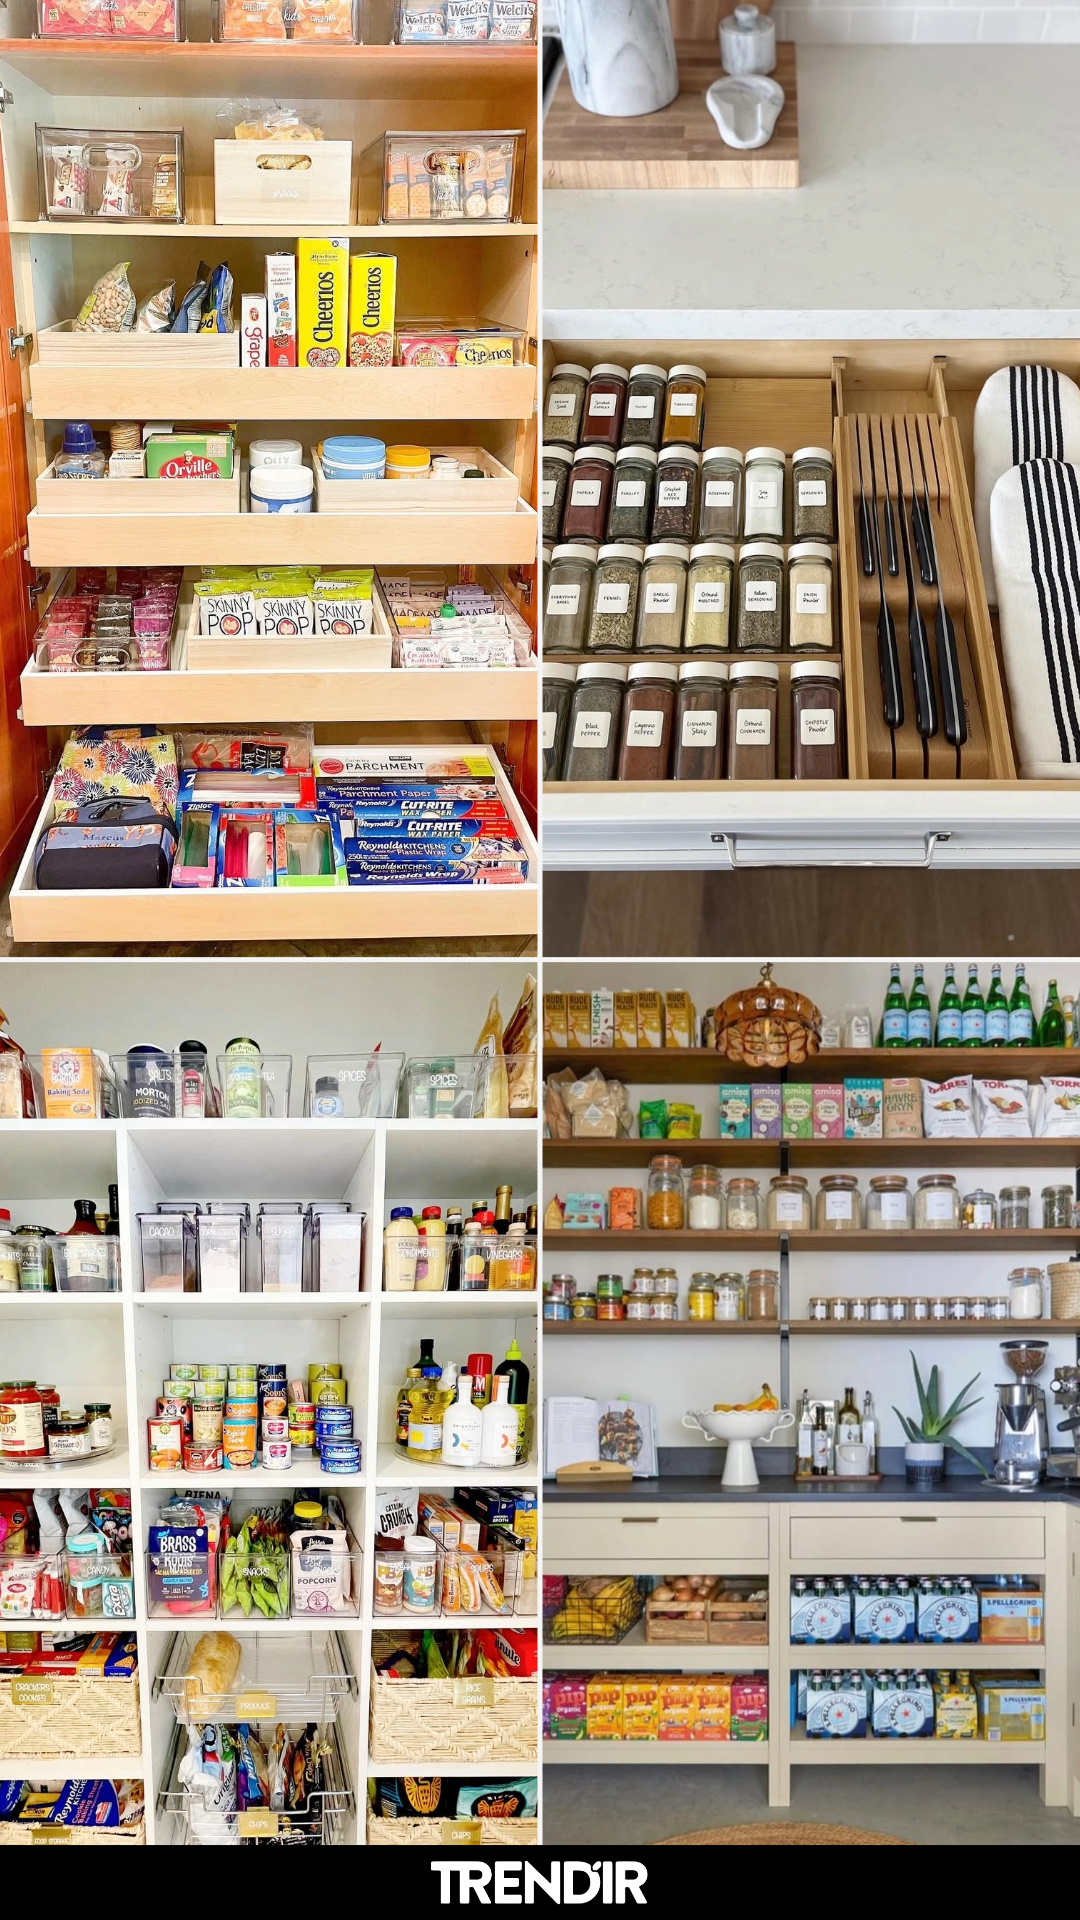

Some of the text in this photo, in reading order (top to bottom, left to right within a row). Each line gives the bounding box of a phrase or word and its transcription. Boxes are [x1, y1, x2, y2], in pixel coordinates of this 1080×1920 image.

[449, 1, 489, 17] Welch's
[496, 4, 535, 16] Welch's
[405, 15, 442, 25] Welch's
[362, 267, 382, 328] Cheerios
[312, 271, 334, 343] Cheerios
[263, 455, 292, 466] OLLY
[165, 460, 213, 479] Orville
[207, 593, 251, 613] SKINNY
[262, 600, 306, 617] SKINNY
[317, 603, 363, 619] SKINNY
[208, 611, 254, 636] POP
[264, 616, 310, 636] POP
[319, 619, 366, 635] POP
[633, 721, 655, 732] Cayenne
[743, 719, 763, 727] Ground
[808, 725, 828, 733] Powder
[345, 762, 425, 771] PARCHMENT
[339, 790, 431, 798] Parchment Paper
[187, 803, 213, 811] Ziploc
[400, 801, 454, 810] CUT-RITE
[360, 820, 396, 829] Reynolds
[407, 821, 463, 831] CUT-RITE
[82, 833, 125, 842] Marcus
[365, 871, 459, 881] Reynolds Wrap
[546, 995, 564, 1004] RUDE
[569, 995, 588, 1004] RUDE
[615, 995, 634, 1004] RUDE
[638, 992, 657, 1002] RUDE
[667, 992, 686, 1002] RUDE
[338, 1070, 367, 1082] SPICES
[430, 1074, 458, 1086] SPICES
[135, 1087, 170, 1101] MORTON
[721, 1087, 749, 1096] amisa
[753, 1086, 781, 1095] amisa
[784, 1086, 812, 1095] amisa
[814, 1087, 842, 1095] amisa
[886, 1102, 915, 1112] GRYN
[149, 1226, 175, 1237] CACAO
[270, 1226, 296, 1237] SUGAR
[398, 1247, 440, 1258] CONDIMENTS
[486, 1249, 523, 1260] VINEGARS
[160, 1535, 197, 1553] BRASS
[86, 1566, 111, 1576] CANDY
[242, 1567, 270, 1577] SNACKS
[470, 1563, 494, 1573] SOUPS
[297, 1577, 337, 1585] POPCORN
[15, 1682, 51, 1692] CRACKERS
[465, 1683, 482, 1693] RICE
[18, 1693, 47, 1702] COOKIES
[554, 1689, 586, 1708] pip
[588, 1690, 621, 1708] pip
[624, 1690, 657, 1708] pip
[660, 1693, 694, 1712] pip
[696, 1692, 730, 1712] pip
[732, 1693, 765, 1711] pip
[240, 1701, 272, 1711] PRODUCE
[451, 1831, 472, 1840] CHIPS
